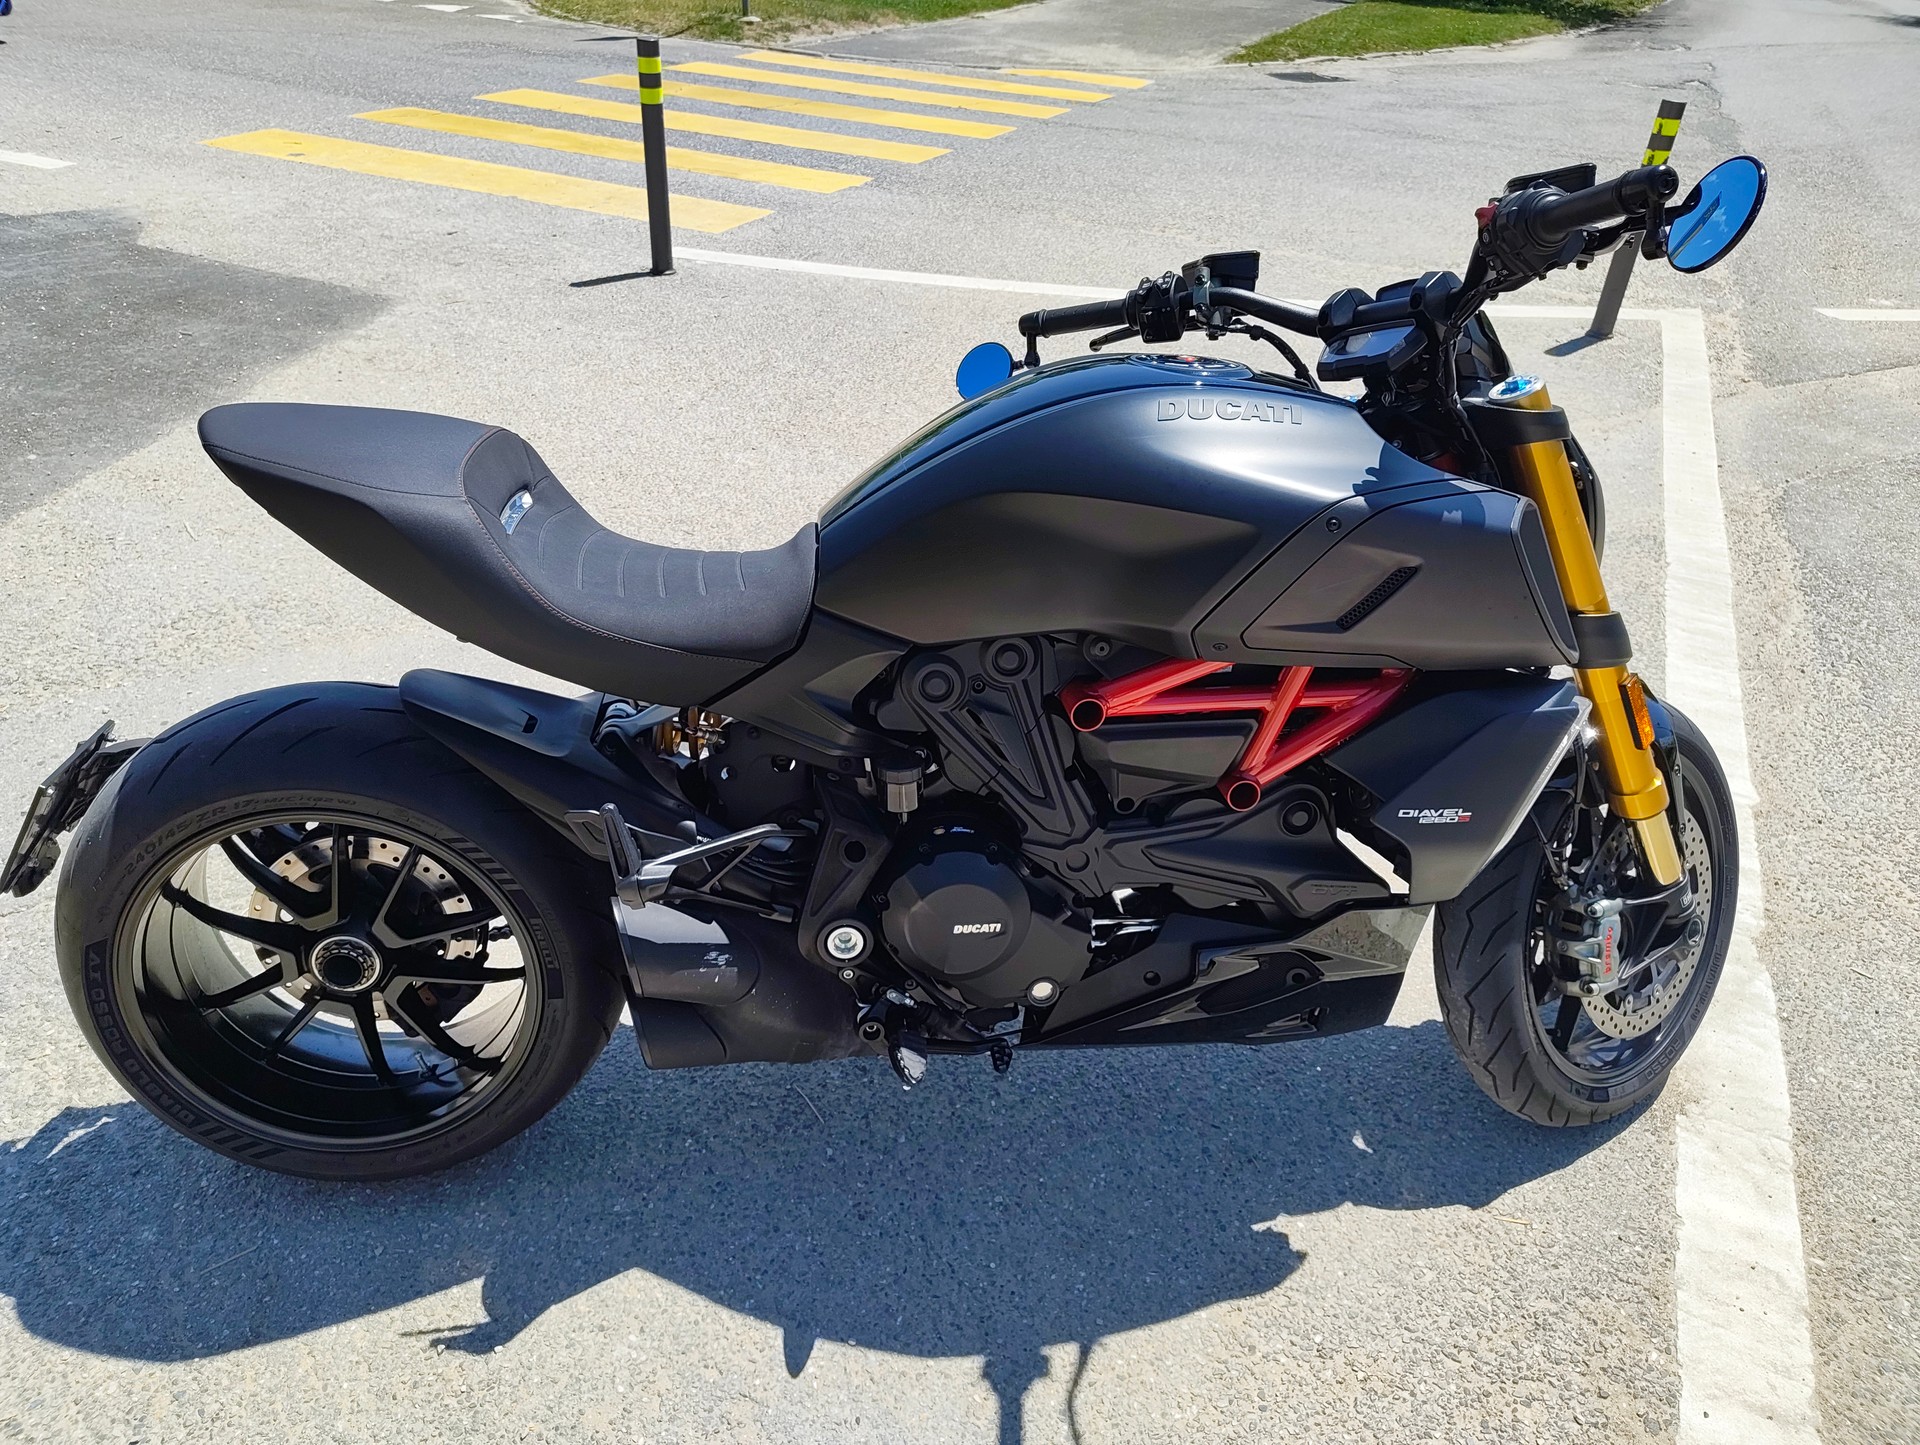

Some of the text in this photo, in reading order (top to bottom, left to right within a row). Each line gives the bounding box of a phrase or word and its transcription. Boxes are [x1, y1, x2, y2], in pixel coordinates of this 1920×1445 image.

[1157, 399, 1303, 425] DUCATI
[1397, 808, 1472, 818] DIAVEL
[528, 917, 560, 970] PIRELLI
[953, 922, 1002, 935] DUCATI
[90, 987, 127, 1053] ROSSO
[1644, 1038, 1681, 1081] ROSSO
